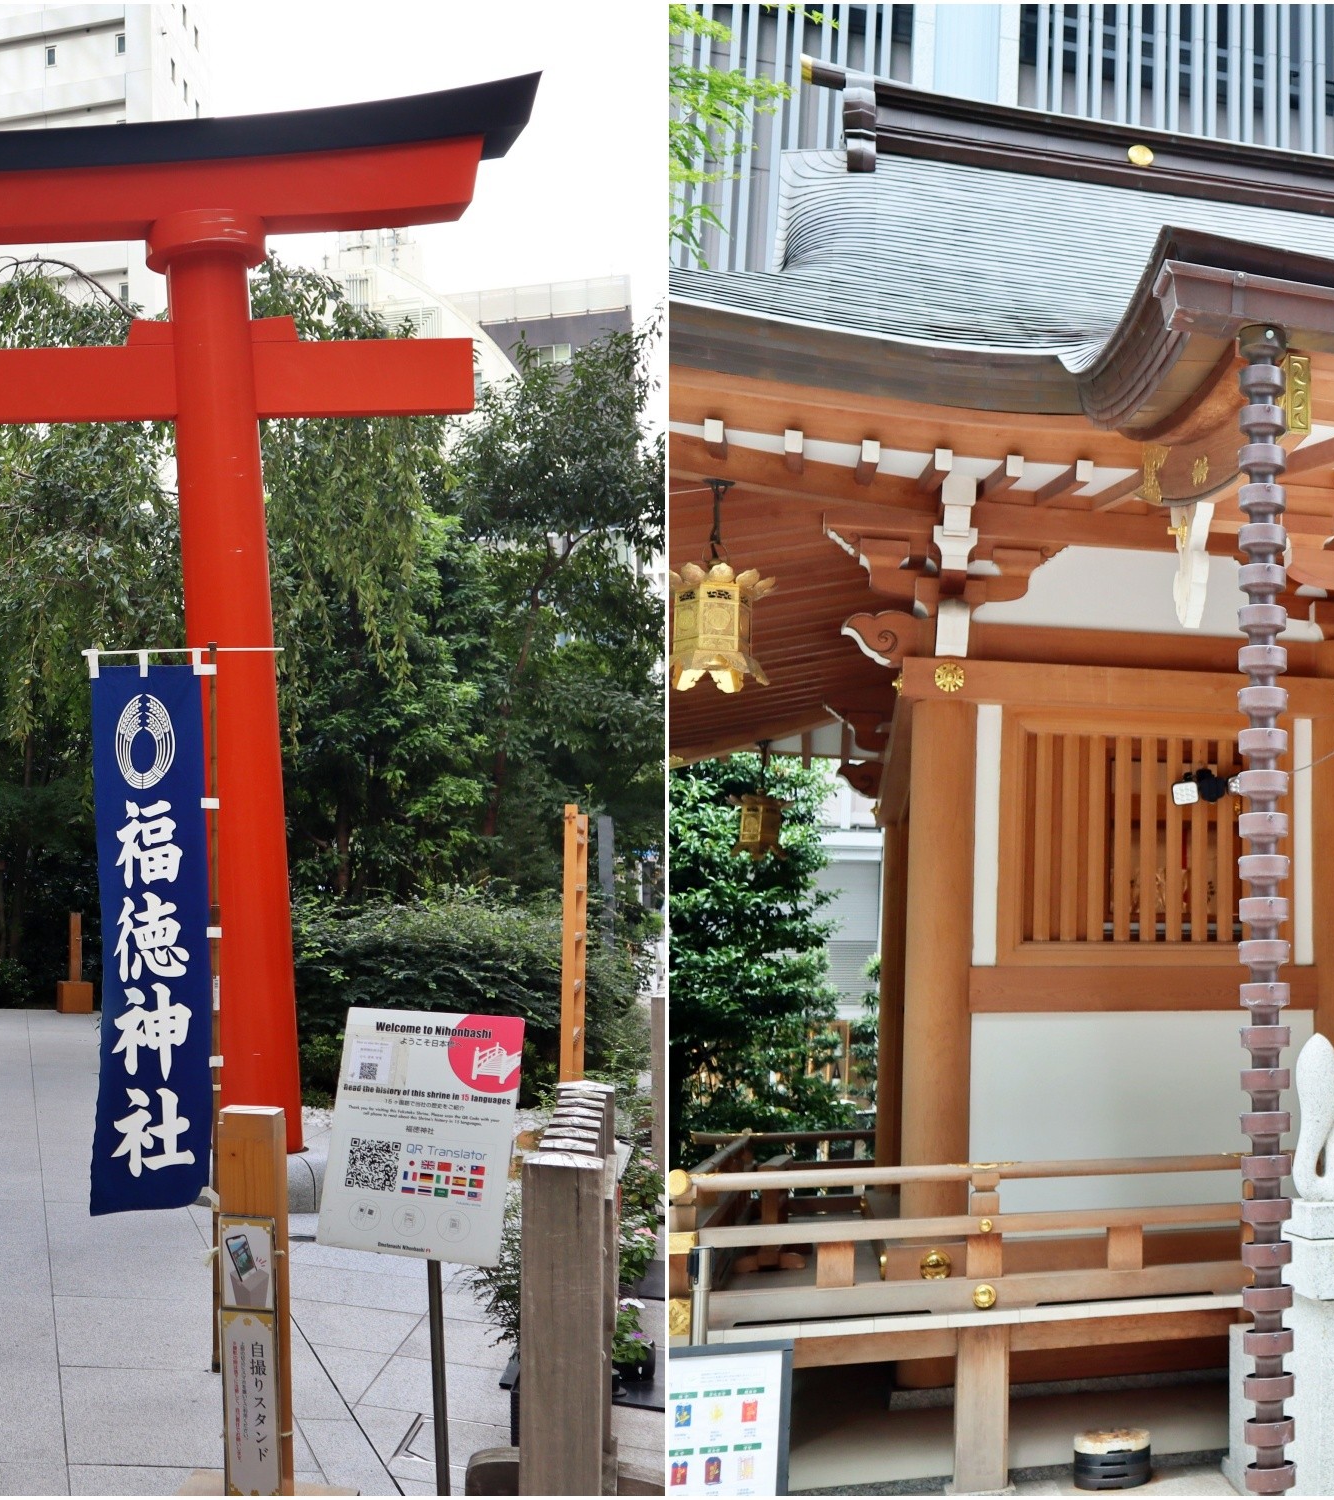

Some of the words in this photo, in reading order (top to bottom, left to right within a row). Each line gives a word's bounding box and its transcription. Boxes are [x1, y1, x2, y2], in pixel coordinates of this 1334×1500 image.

[111, 799, 196, 1178] 福徳神社
[376, 1022, 421, 1035] Welcome
[423, 1025, 433, 1035] to
[435, 1025, 492, 1039] Nihonbashi
[343, 1084, 361, 1092] Read
[363, 1085, 375, 1093] the
[376, 1086, 401, 1097] history
[402, 1088, 410, 1096] of
[412, 1089, 425, 1098] this
[427, 1090, 451, 1100] shrine
[452, 1092, 460, 1100] in
[461, 1093, 470, 1102] 15
[471, 1094, 511, 1106] languages
[406, 1143, 423, 1155] QR
[427, 1145, 488, 1161] Translator
[250, 1341, 269, 1462] 自撮りスタンド
